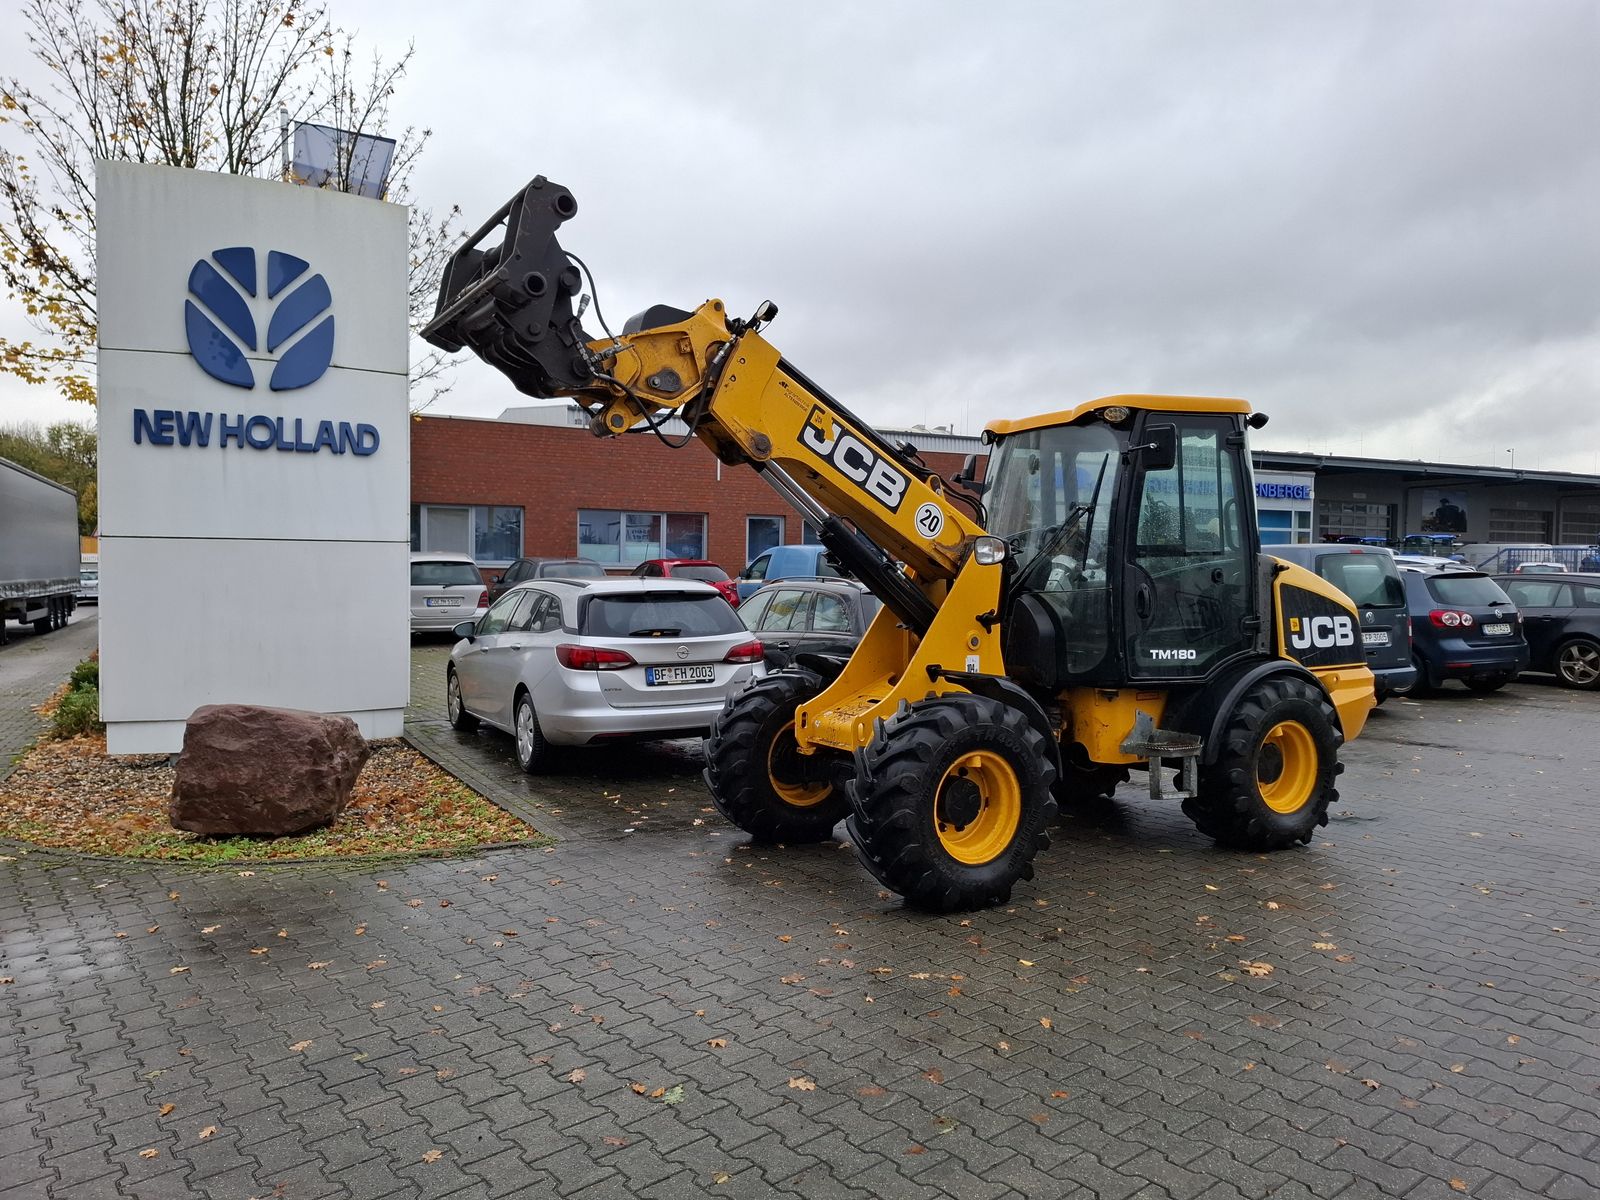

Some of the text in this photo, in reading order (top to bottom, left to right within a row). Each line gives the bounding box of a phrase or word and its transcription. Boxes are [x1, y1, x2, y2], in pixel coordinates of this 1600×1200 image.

[133, 408, 380, 456] NEW HOLLAND
[803, 422, 906, 507] JCB
[919, 508, 940, 533] 20
[1291, 616, 1355, 649] JCB
[1150, 649, 1196, 660] TM180
[654, 666, 713, 681] BF FH 2003
